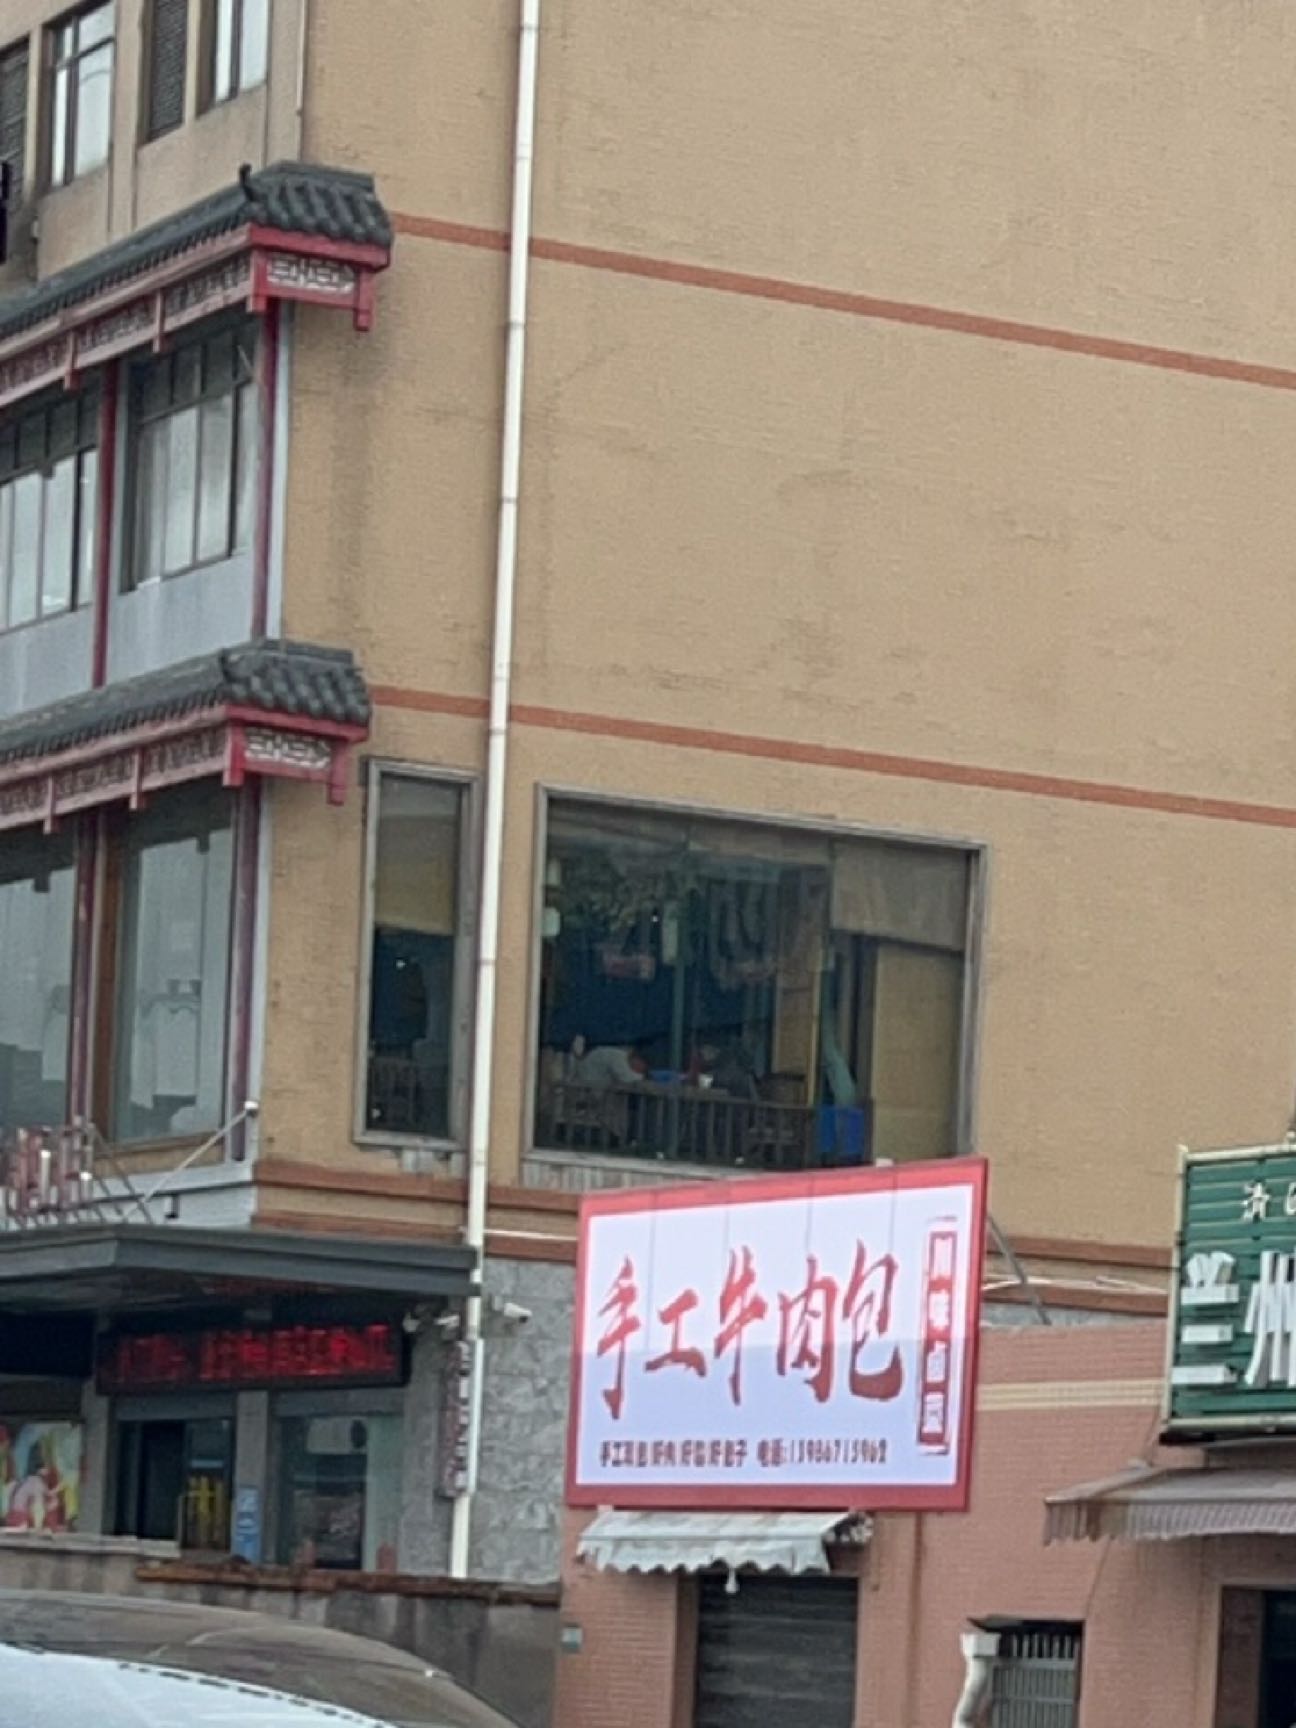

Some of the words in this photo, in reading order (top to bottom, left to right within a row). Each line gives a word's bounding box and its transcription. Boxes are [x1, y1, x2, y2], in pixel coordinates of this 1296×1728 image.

[596, 1238, 904, 1420] 手工牛肉包
